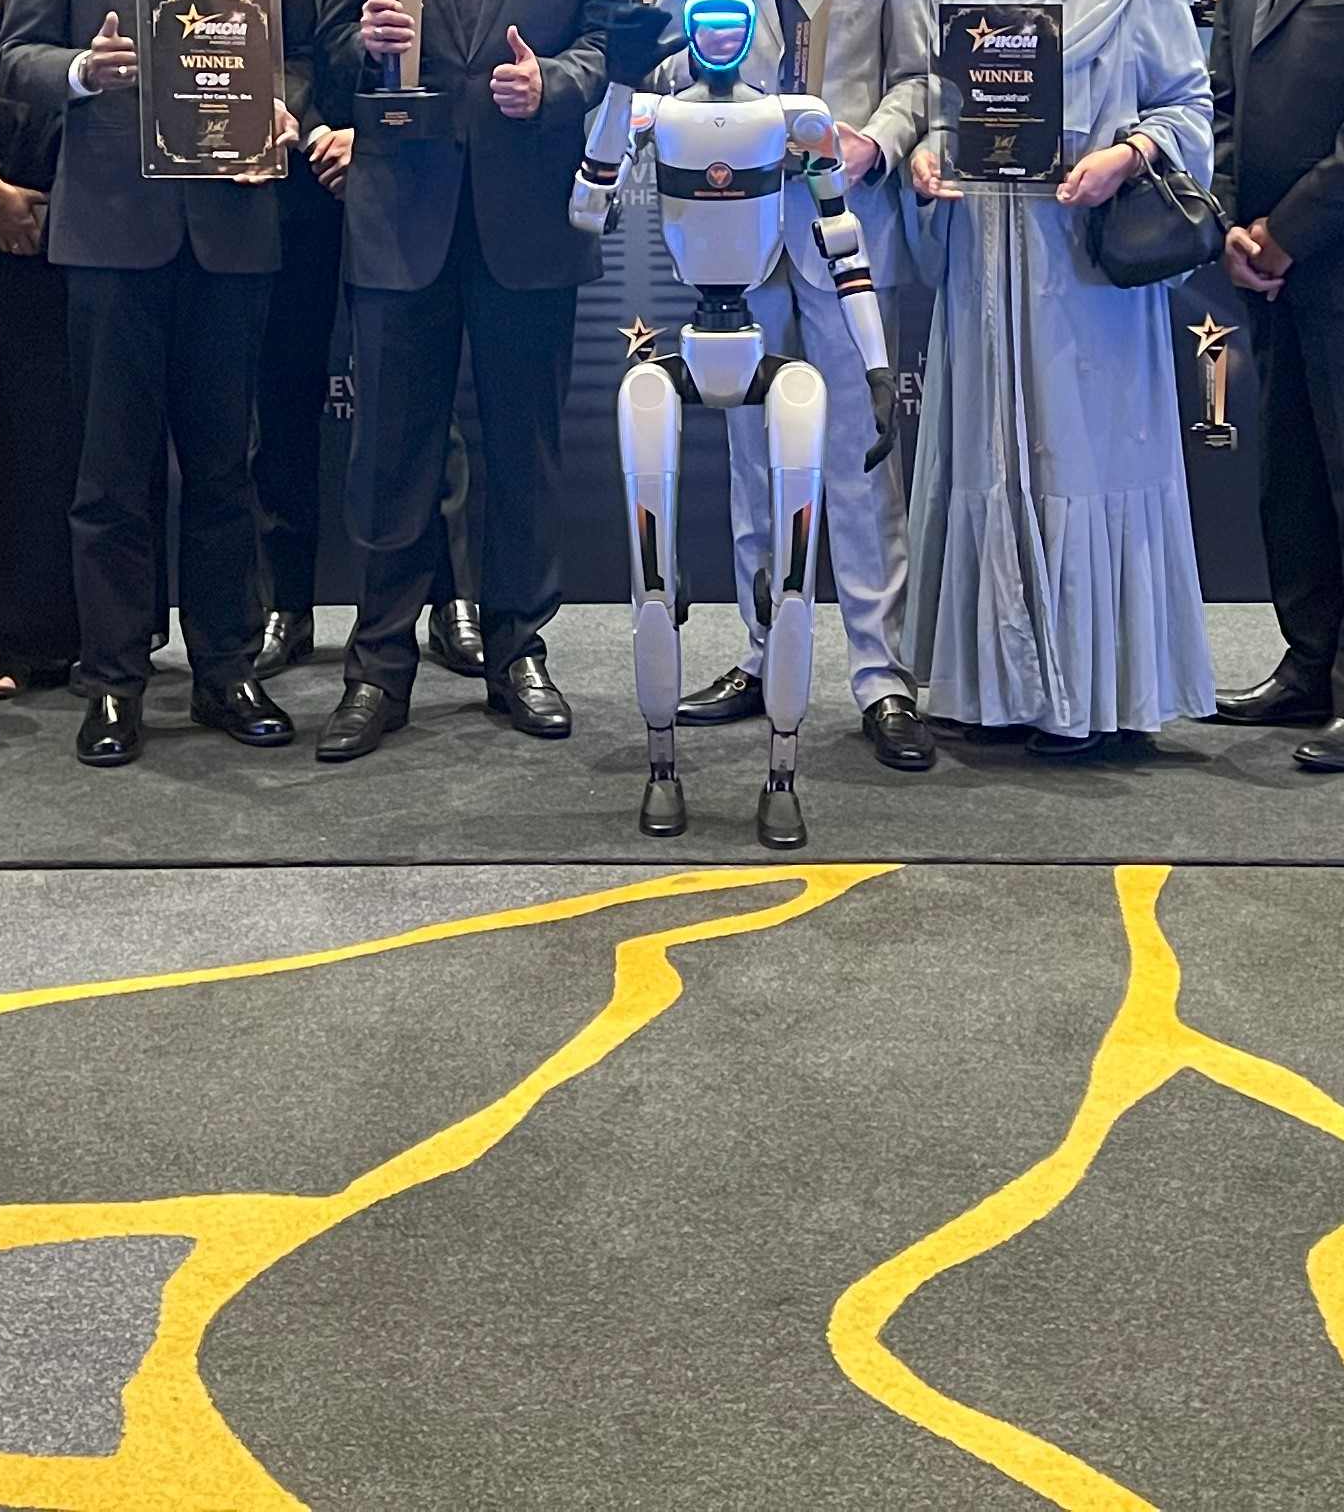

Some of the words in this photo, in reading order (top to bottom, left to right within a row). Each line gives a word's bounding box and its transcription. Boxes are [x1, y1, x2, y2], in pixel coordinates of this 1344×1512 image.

[194, 22, 248, 35] PIKOM
[984, 35, 1038, 48] PIKOM
[179, 55, 245, 69] WINNER
[969, 69, 1034, 83] WINNER
